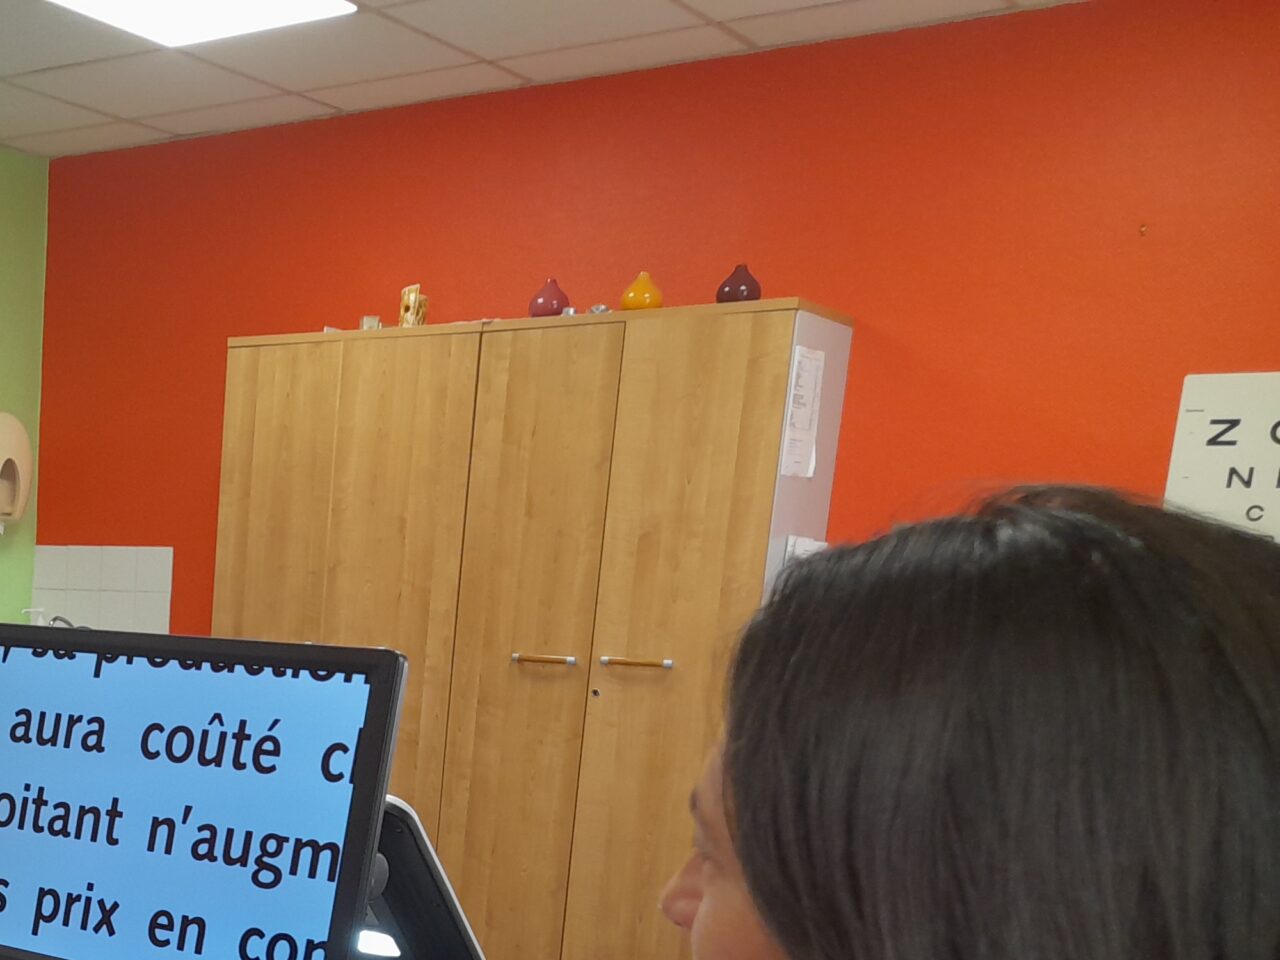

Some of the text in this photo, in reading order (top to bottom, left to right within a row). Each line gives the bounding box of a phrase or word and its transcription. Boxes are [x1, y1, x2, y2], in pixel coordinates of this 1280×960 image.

[1206, 419, 1241, 446] Z
[1226, 467, 1254, 489] N
[1246, 505, 1265, 522] C
[9, 708, 106, 753] aura
[140, 712, 282, 774] coûté
[320, 727, 363, 785] c
[31, 882, 120, 937] prix
[147, 909, 207, 955] en
